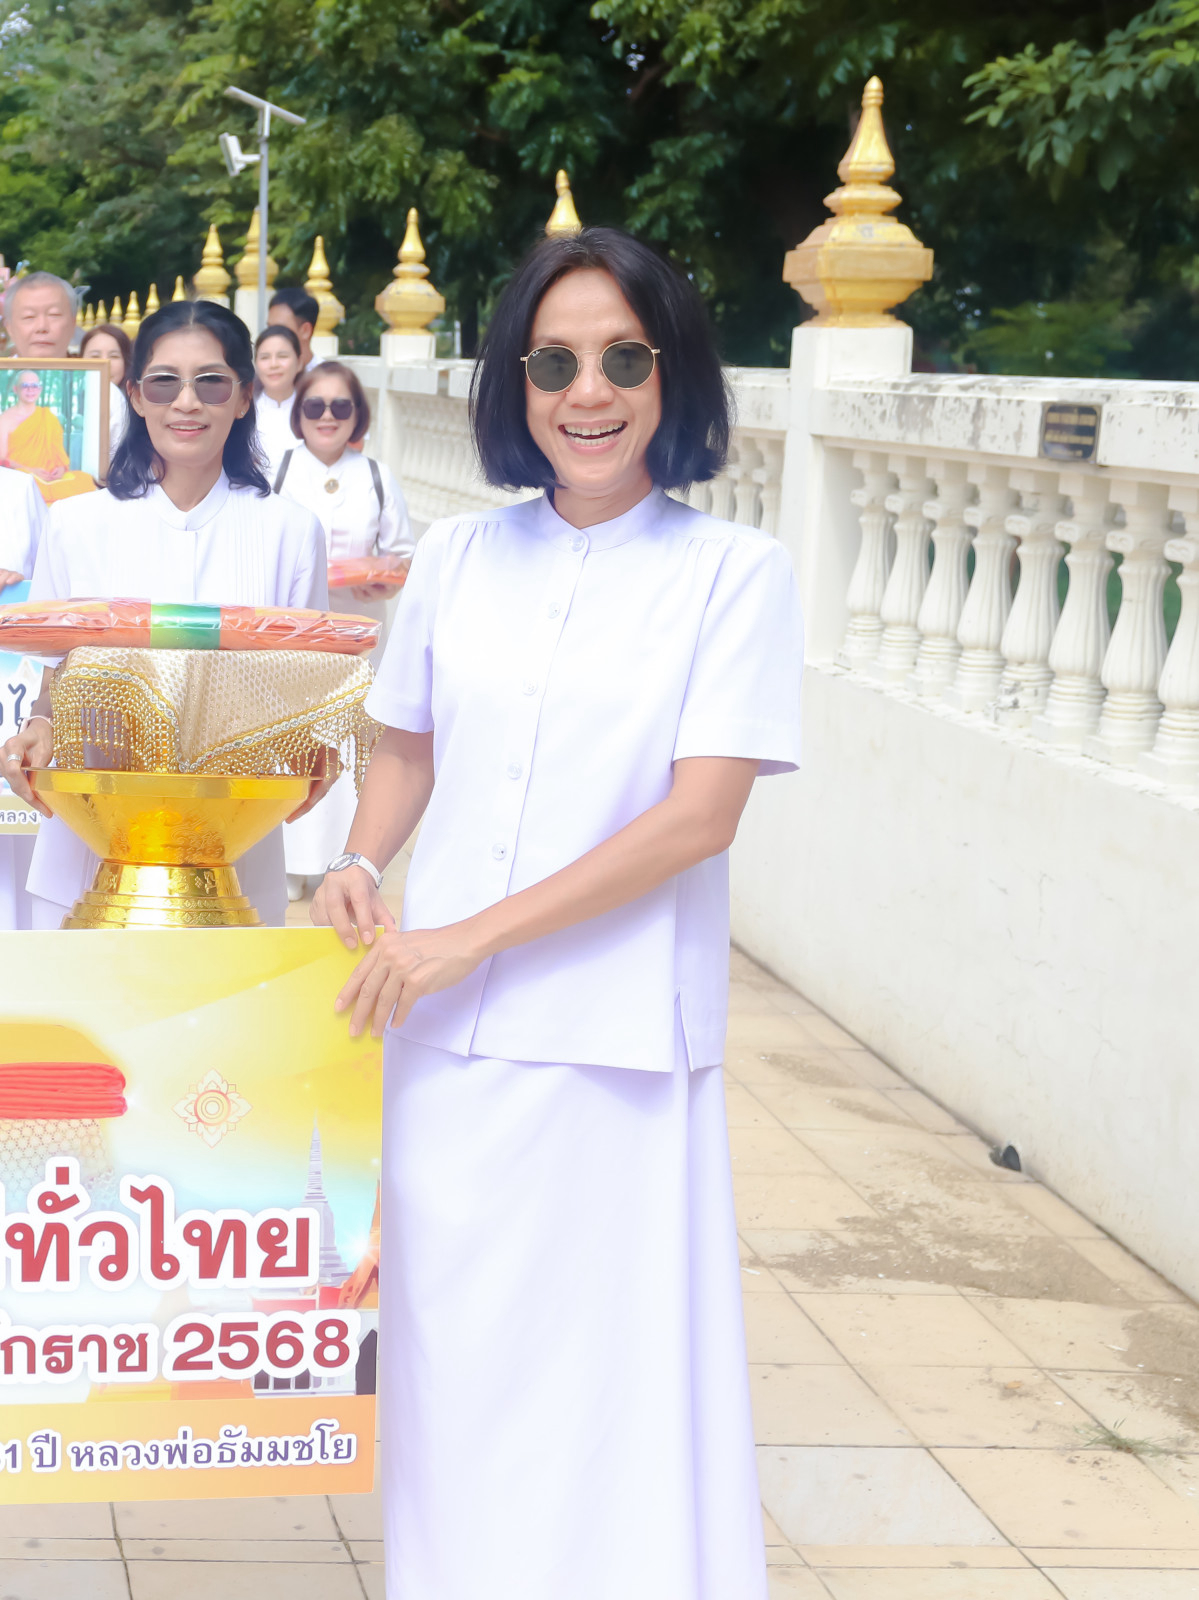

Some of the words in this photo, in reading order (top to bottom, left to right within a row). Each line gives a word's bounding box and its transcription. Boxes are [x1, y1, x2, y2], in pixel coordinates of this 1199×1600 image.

[172, 1318, 352, 1372] 2568
[32, 1433, 59, 1470] ปี
[70, 1423, 354, 1468] หลวงพ่อธัมมชโย
